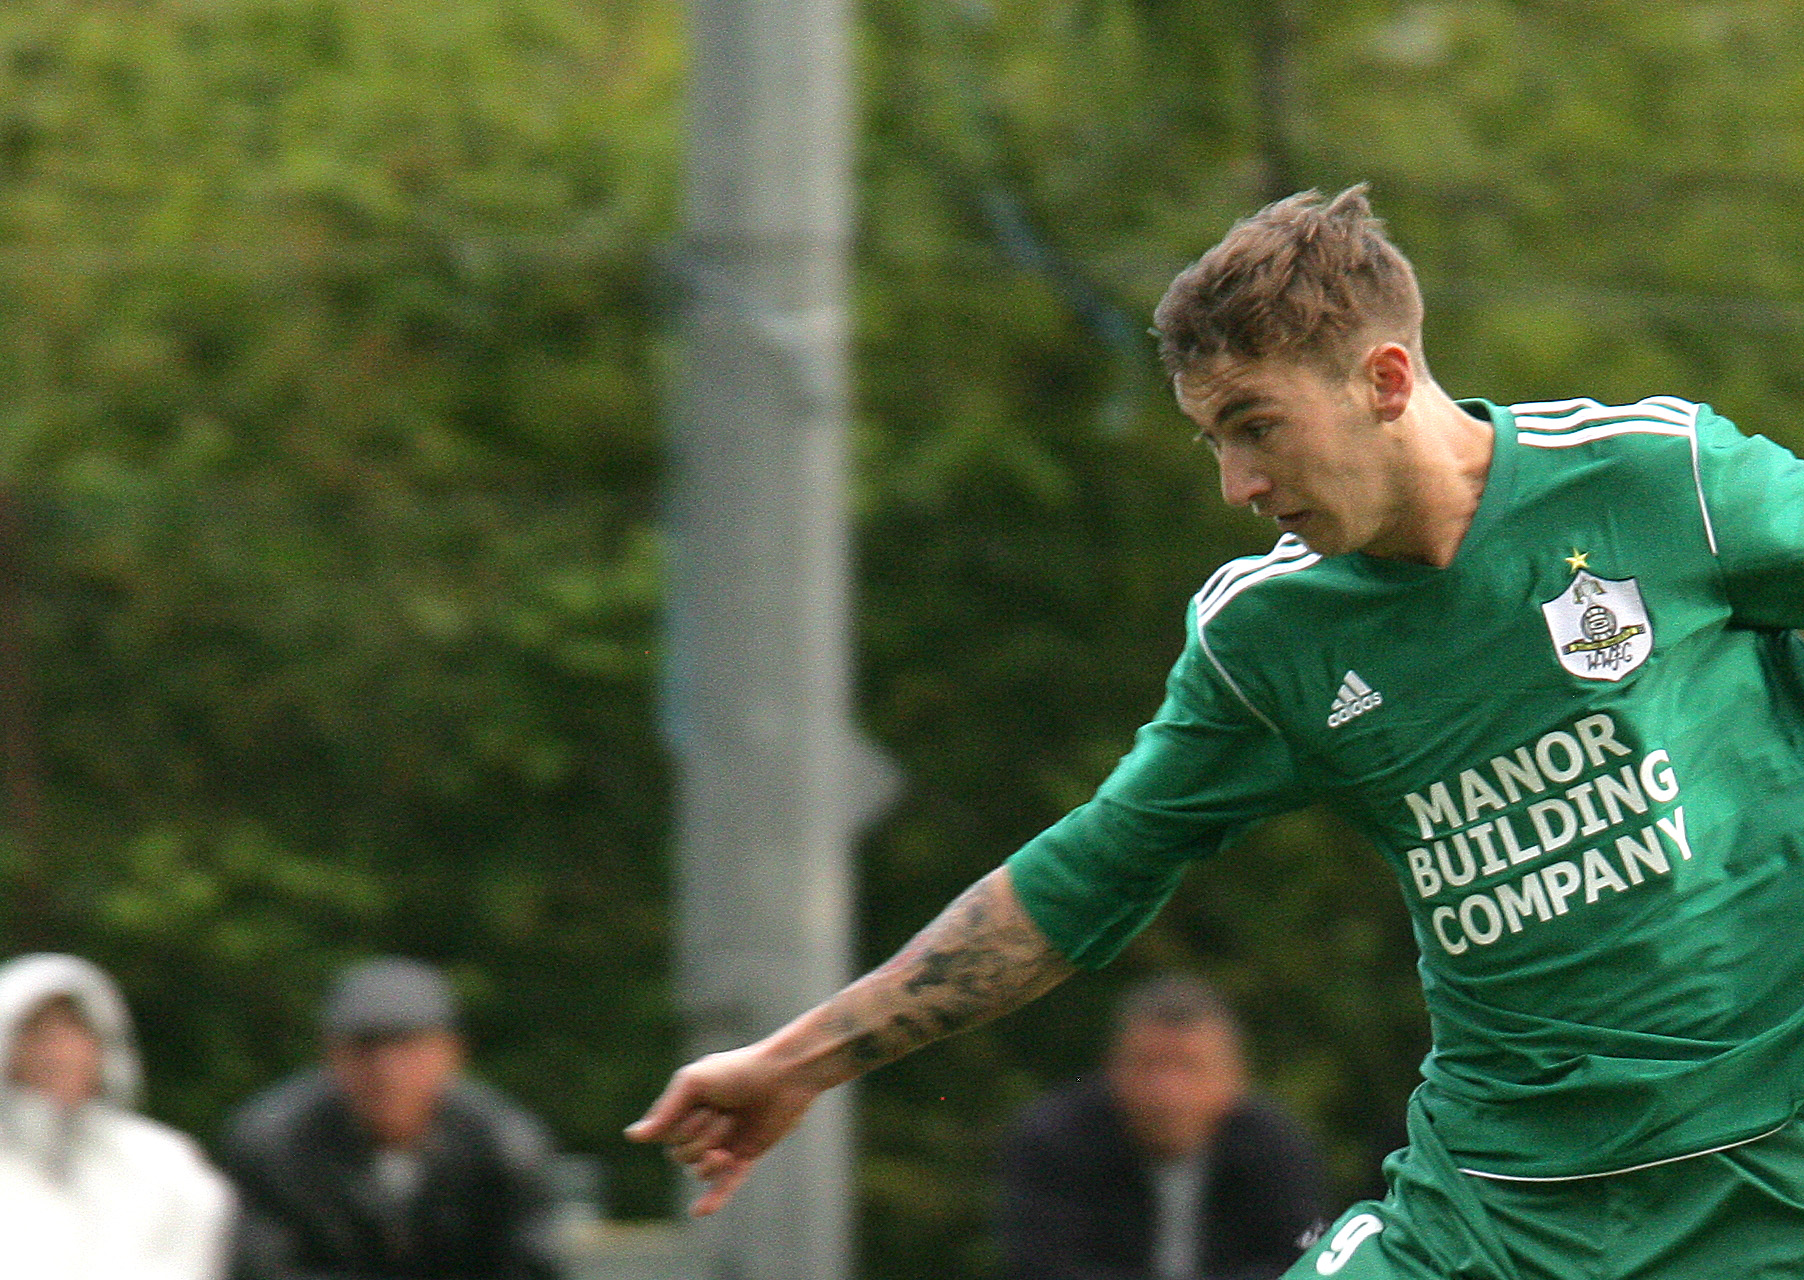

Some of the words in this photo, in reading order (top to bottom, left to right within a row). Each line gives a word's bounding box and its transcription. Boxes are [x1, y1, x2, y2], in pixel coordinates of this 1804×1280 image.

[1327, 691, 1383, 729] adidas
[1404, 713, 1633, 840] MANOR
[1406, 749, 1680, 898] BUILDING
[1432, 806, 1692, 955] COMPANY
[1316, 1213, 1384, 1276] 9
